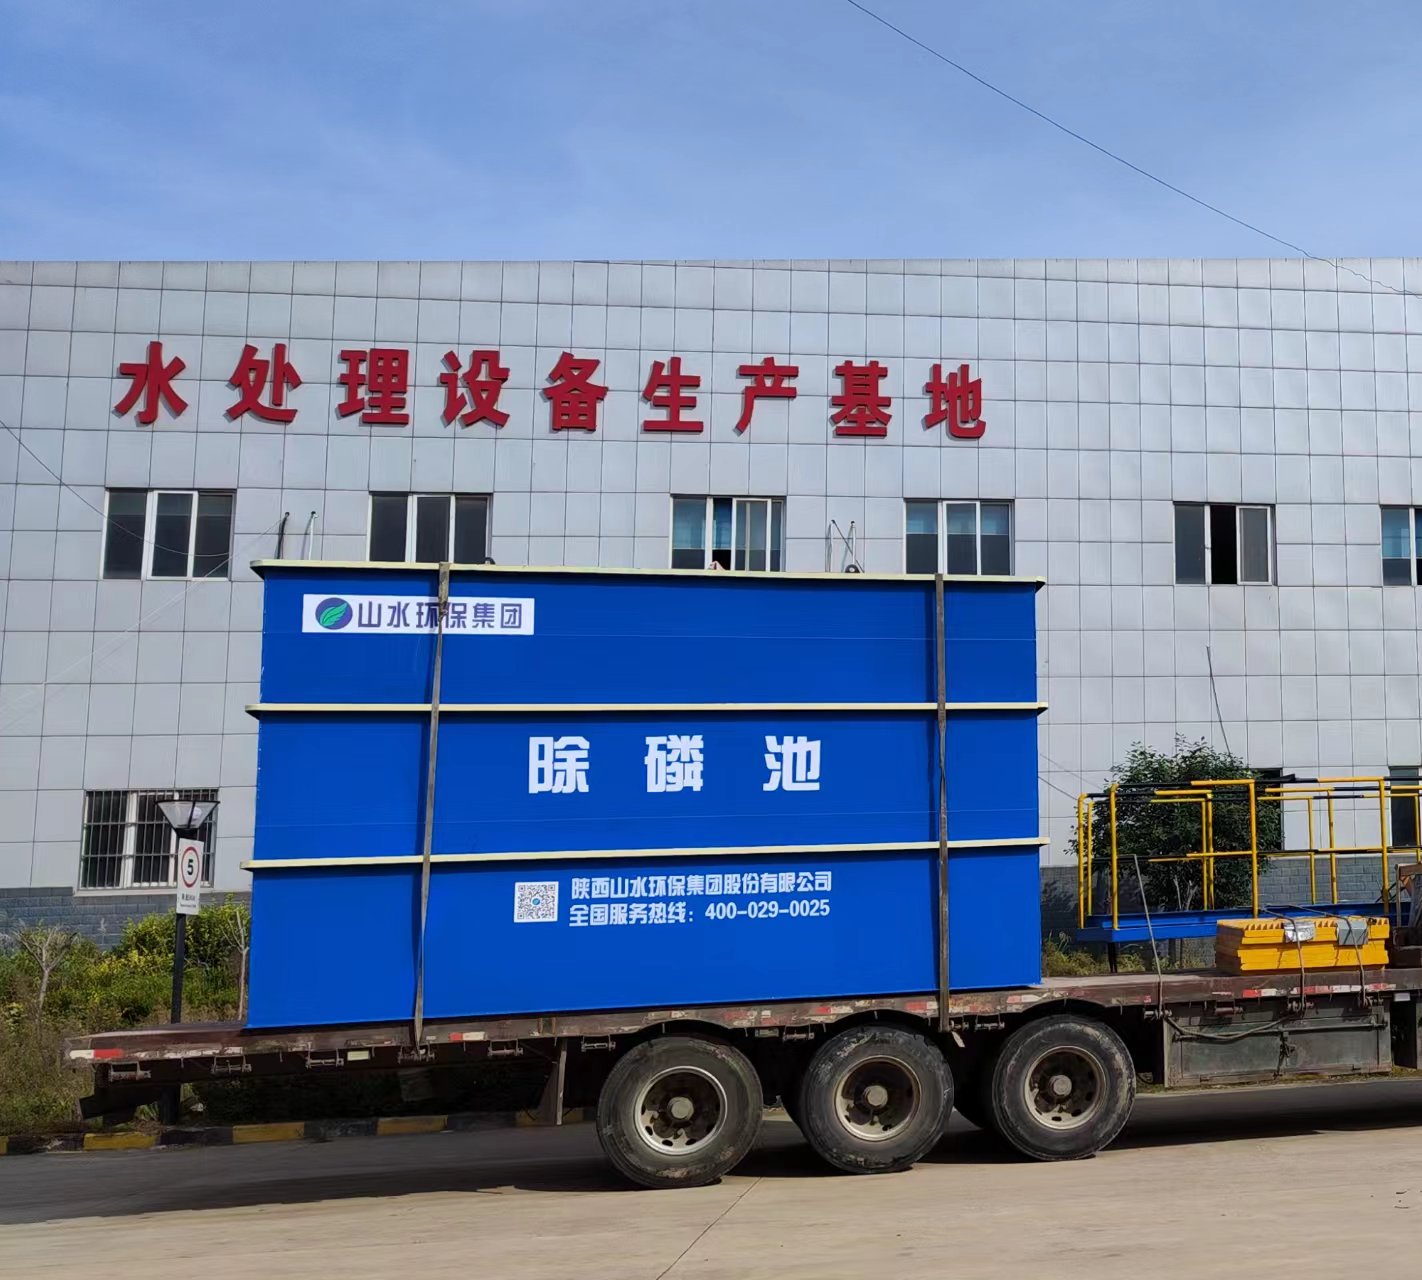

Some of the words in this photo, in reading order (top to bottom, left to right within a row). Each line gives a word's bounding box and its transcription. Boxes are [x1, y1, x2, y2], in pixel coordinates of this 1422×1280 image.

[115, 341, 986, 439] 水处理设备生产基地
[357, 600, 523, 629] 山水环保集团
[528, 734, 821, 794] 除磷池
[187, 859, 194, 875] 5
[571, 871, 832, 899] 陕西山水环保集团股份有限公司
